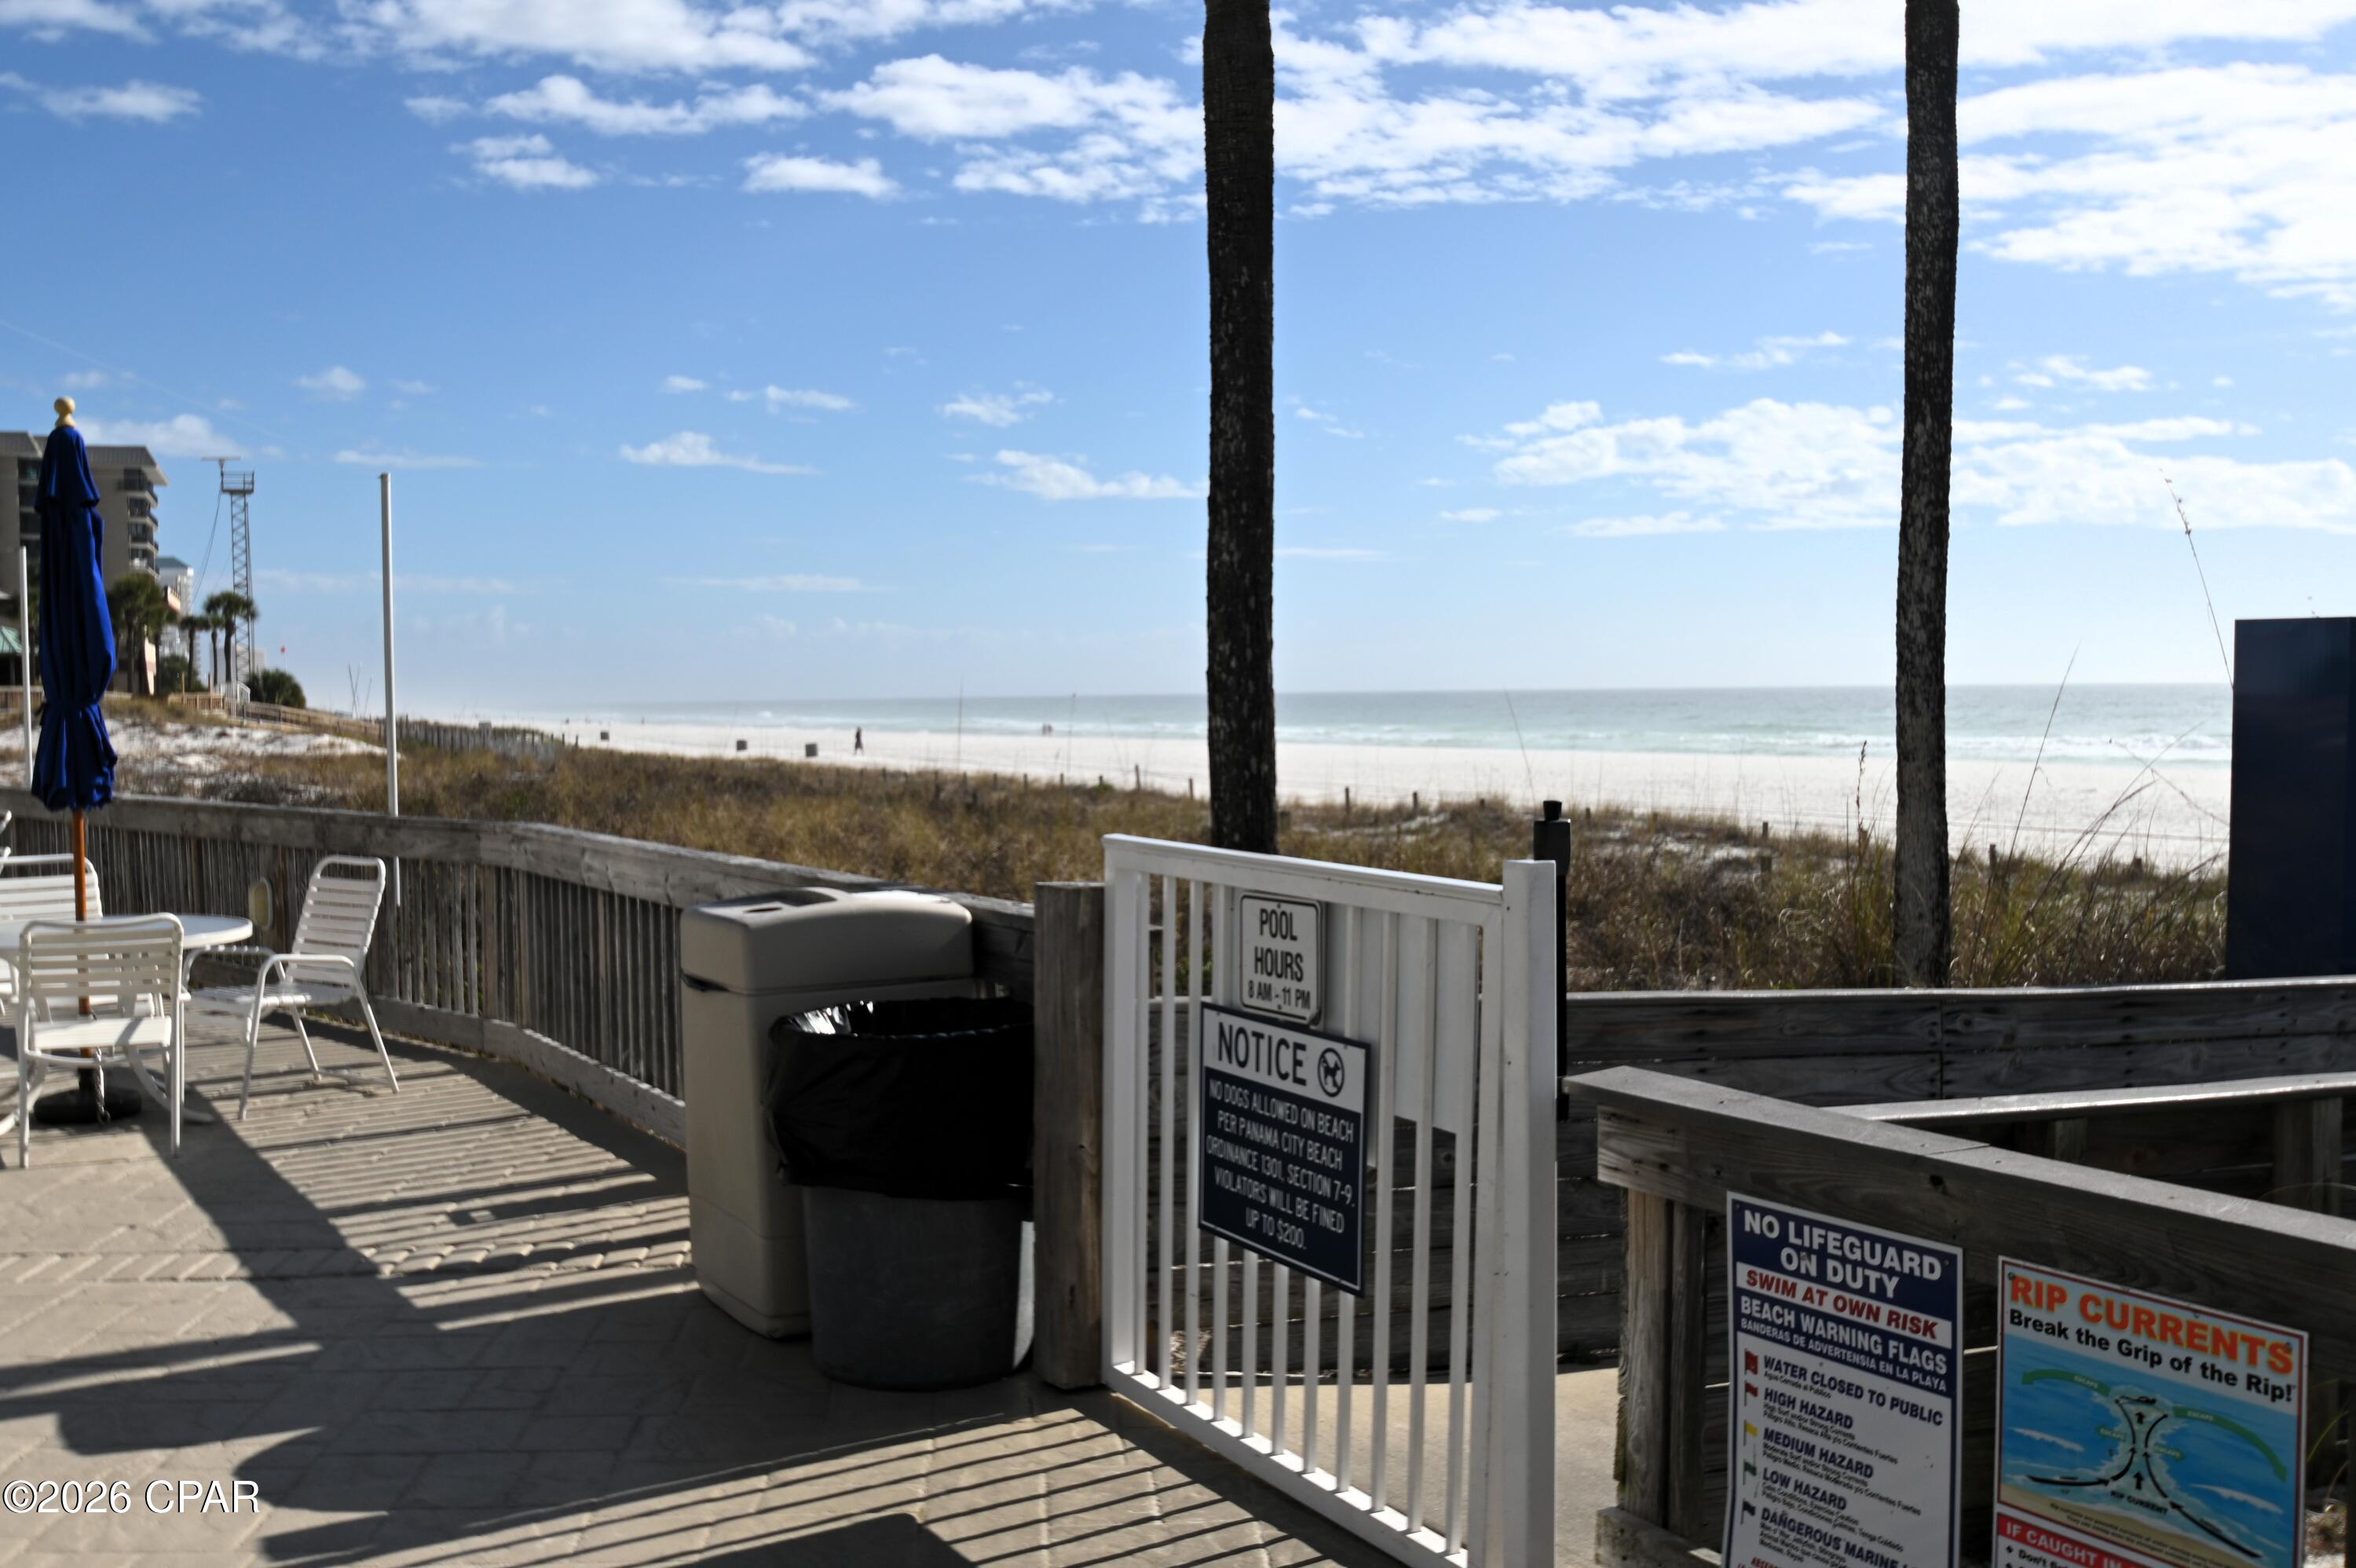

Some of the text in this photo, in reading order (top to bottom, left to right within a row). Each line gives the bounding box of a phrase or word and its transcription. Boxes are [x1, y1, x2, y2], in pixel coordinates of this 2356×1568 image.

[1260, 908, 1297, 941] POOL
[1249, 980, 1254, 998] 8
[1257, 981, 1272, 1002] AM
[1282, 987, 1291, 1007] 11
[1296, 988, 1310, 1010] PM
[1254, 946, 1303, 982] HOURS
[1218, 1022, 1307, 1086] NOTICE
[1209, 1079, 1354, 1143] NO DOGS ALLOWED ON BEACH
[1218, 1109, 1343, 1171] PER PANAMA CITY BEACH
[1205, 1135, 1258, 1171] ORDINANCE
[1286, 1164, 1332, 1198] SECTION
[1333, 1179, 1355, 1208] 7-9.
[1214, 1165, 1345, 1234] VIOLATORS WILL BE FINED
[1246, 1207, 1307, 1250] UP TO $200.
[1744, 1209, 1941, 1281] NO LIFEGUARD
[1747, 1269, 1938, 1340] SWIM AT OWN RISK
[1780, 1247, 1900, 1299] ON DUTY
[1740, 1296, 1948, 1375] BEACH WARNING FLAGS
[1740, 1318, 1946, 1393] BANDERAS DE ADVERTENSIA EN LA PLAYA
[2009, 1308, 2292, 1404] Break the Grip of the Rip!
[2010, 1274, 2295, 1376] RIP CURRENTS
[1764, 1355, 1943, 1427] WATER CLOSED TO PUBLIC
[1764, 1387, 1853, 1429] HIGH HAZARD
[1763, 1427, 1874, 1479] MEDIUM HAZARD
[1762, 1467, 1791, 1489] LOW
[1794, 1479, 1847, 1511] HAZARD
[1762, 1508, 1842, 1552] DANGEROUS
[1844, 1541, 1899, 1568] MARINE
[2006, 1521, 2022, 1538] IF
[2026, 1530, 2098, 1567] CAUGHT
